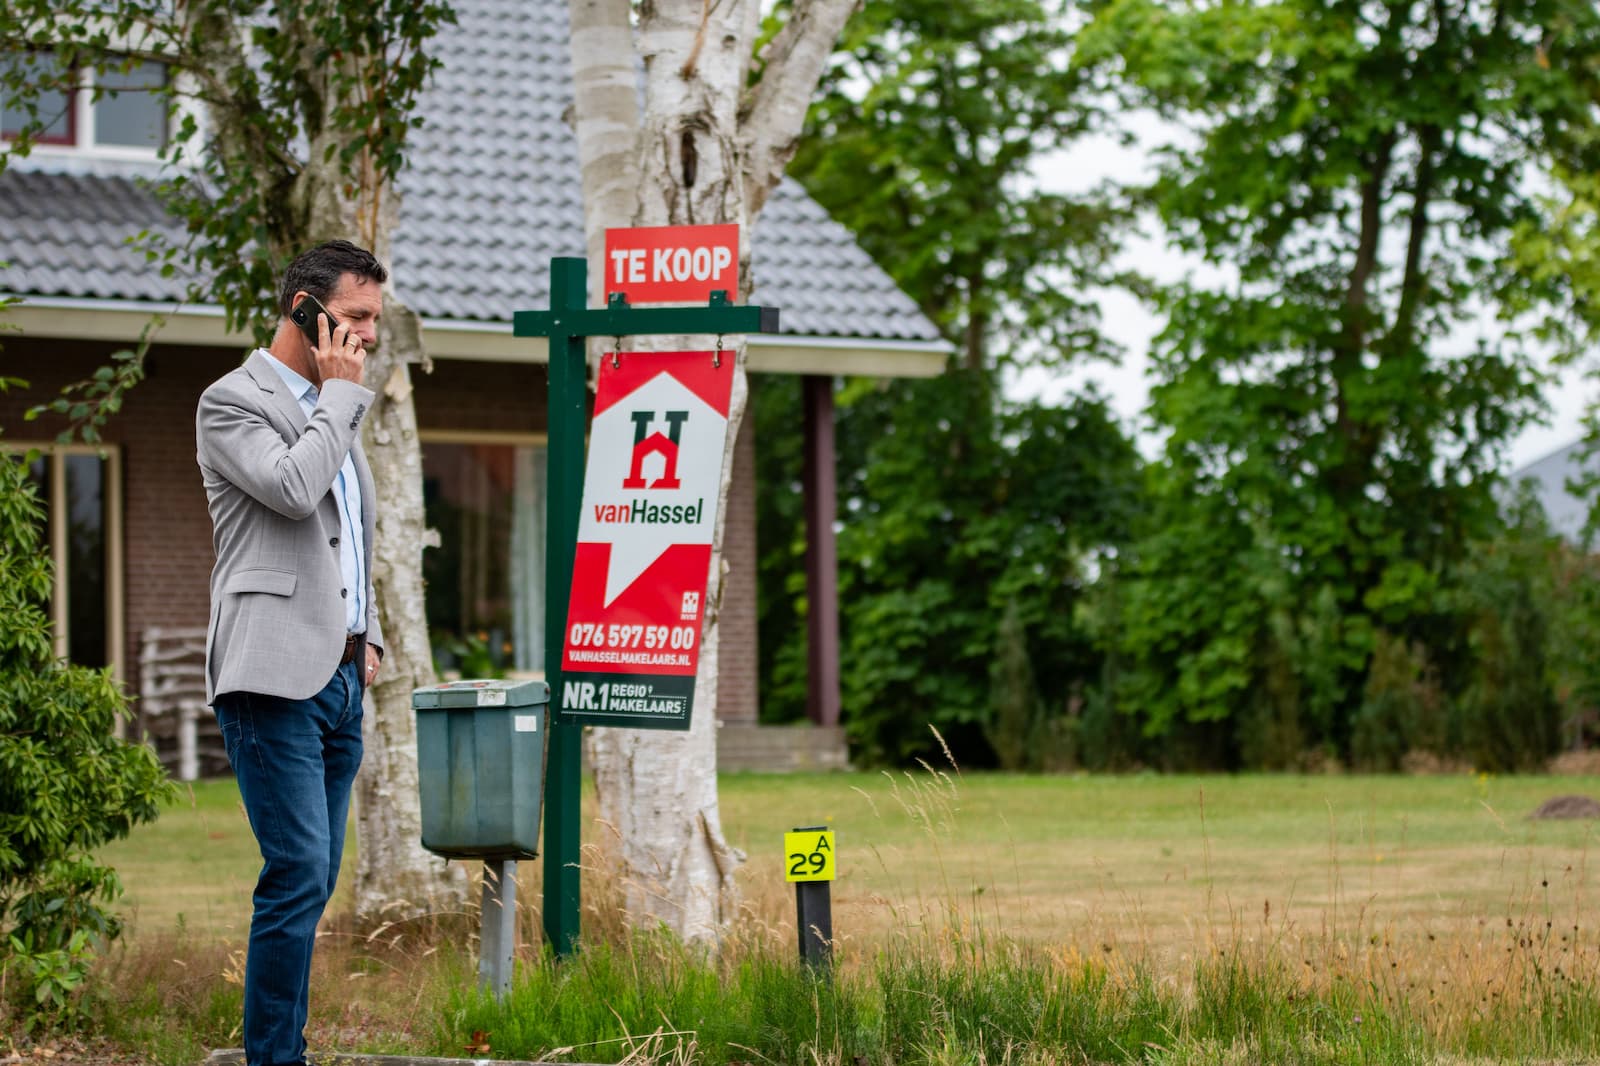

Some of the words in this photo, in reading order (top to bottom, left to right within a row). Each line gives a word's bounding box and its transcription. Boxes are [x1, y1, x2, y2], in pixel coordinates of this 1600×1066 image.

[611, 249, 646, 283] TE
[653, 246, 731, 282] KOOP
[594, 498, 703, 524] vanHassel
[570, 623, 604, 646] 076
[608, 624, 643, 648] 597
[645, 626, 668, 648] 59
[671, 627, 694, 650] 00
[568, 650, 691, 666] VANHASSELMAKELAARS.NL
[562, 681, 609, 710] NR.1
[611, 683, 647, 698] REGIO
[609, 698, 682, 714] MAKELAARS
[816, 835, 831, 851] A
[790, 852, 826, 875] 29
